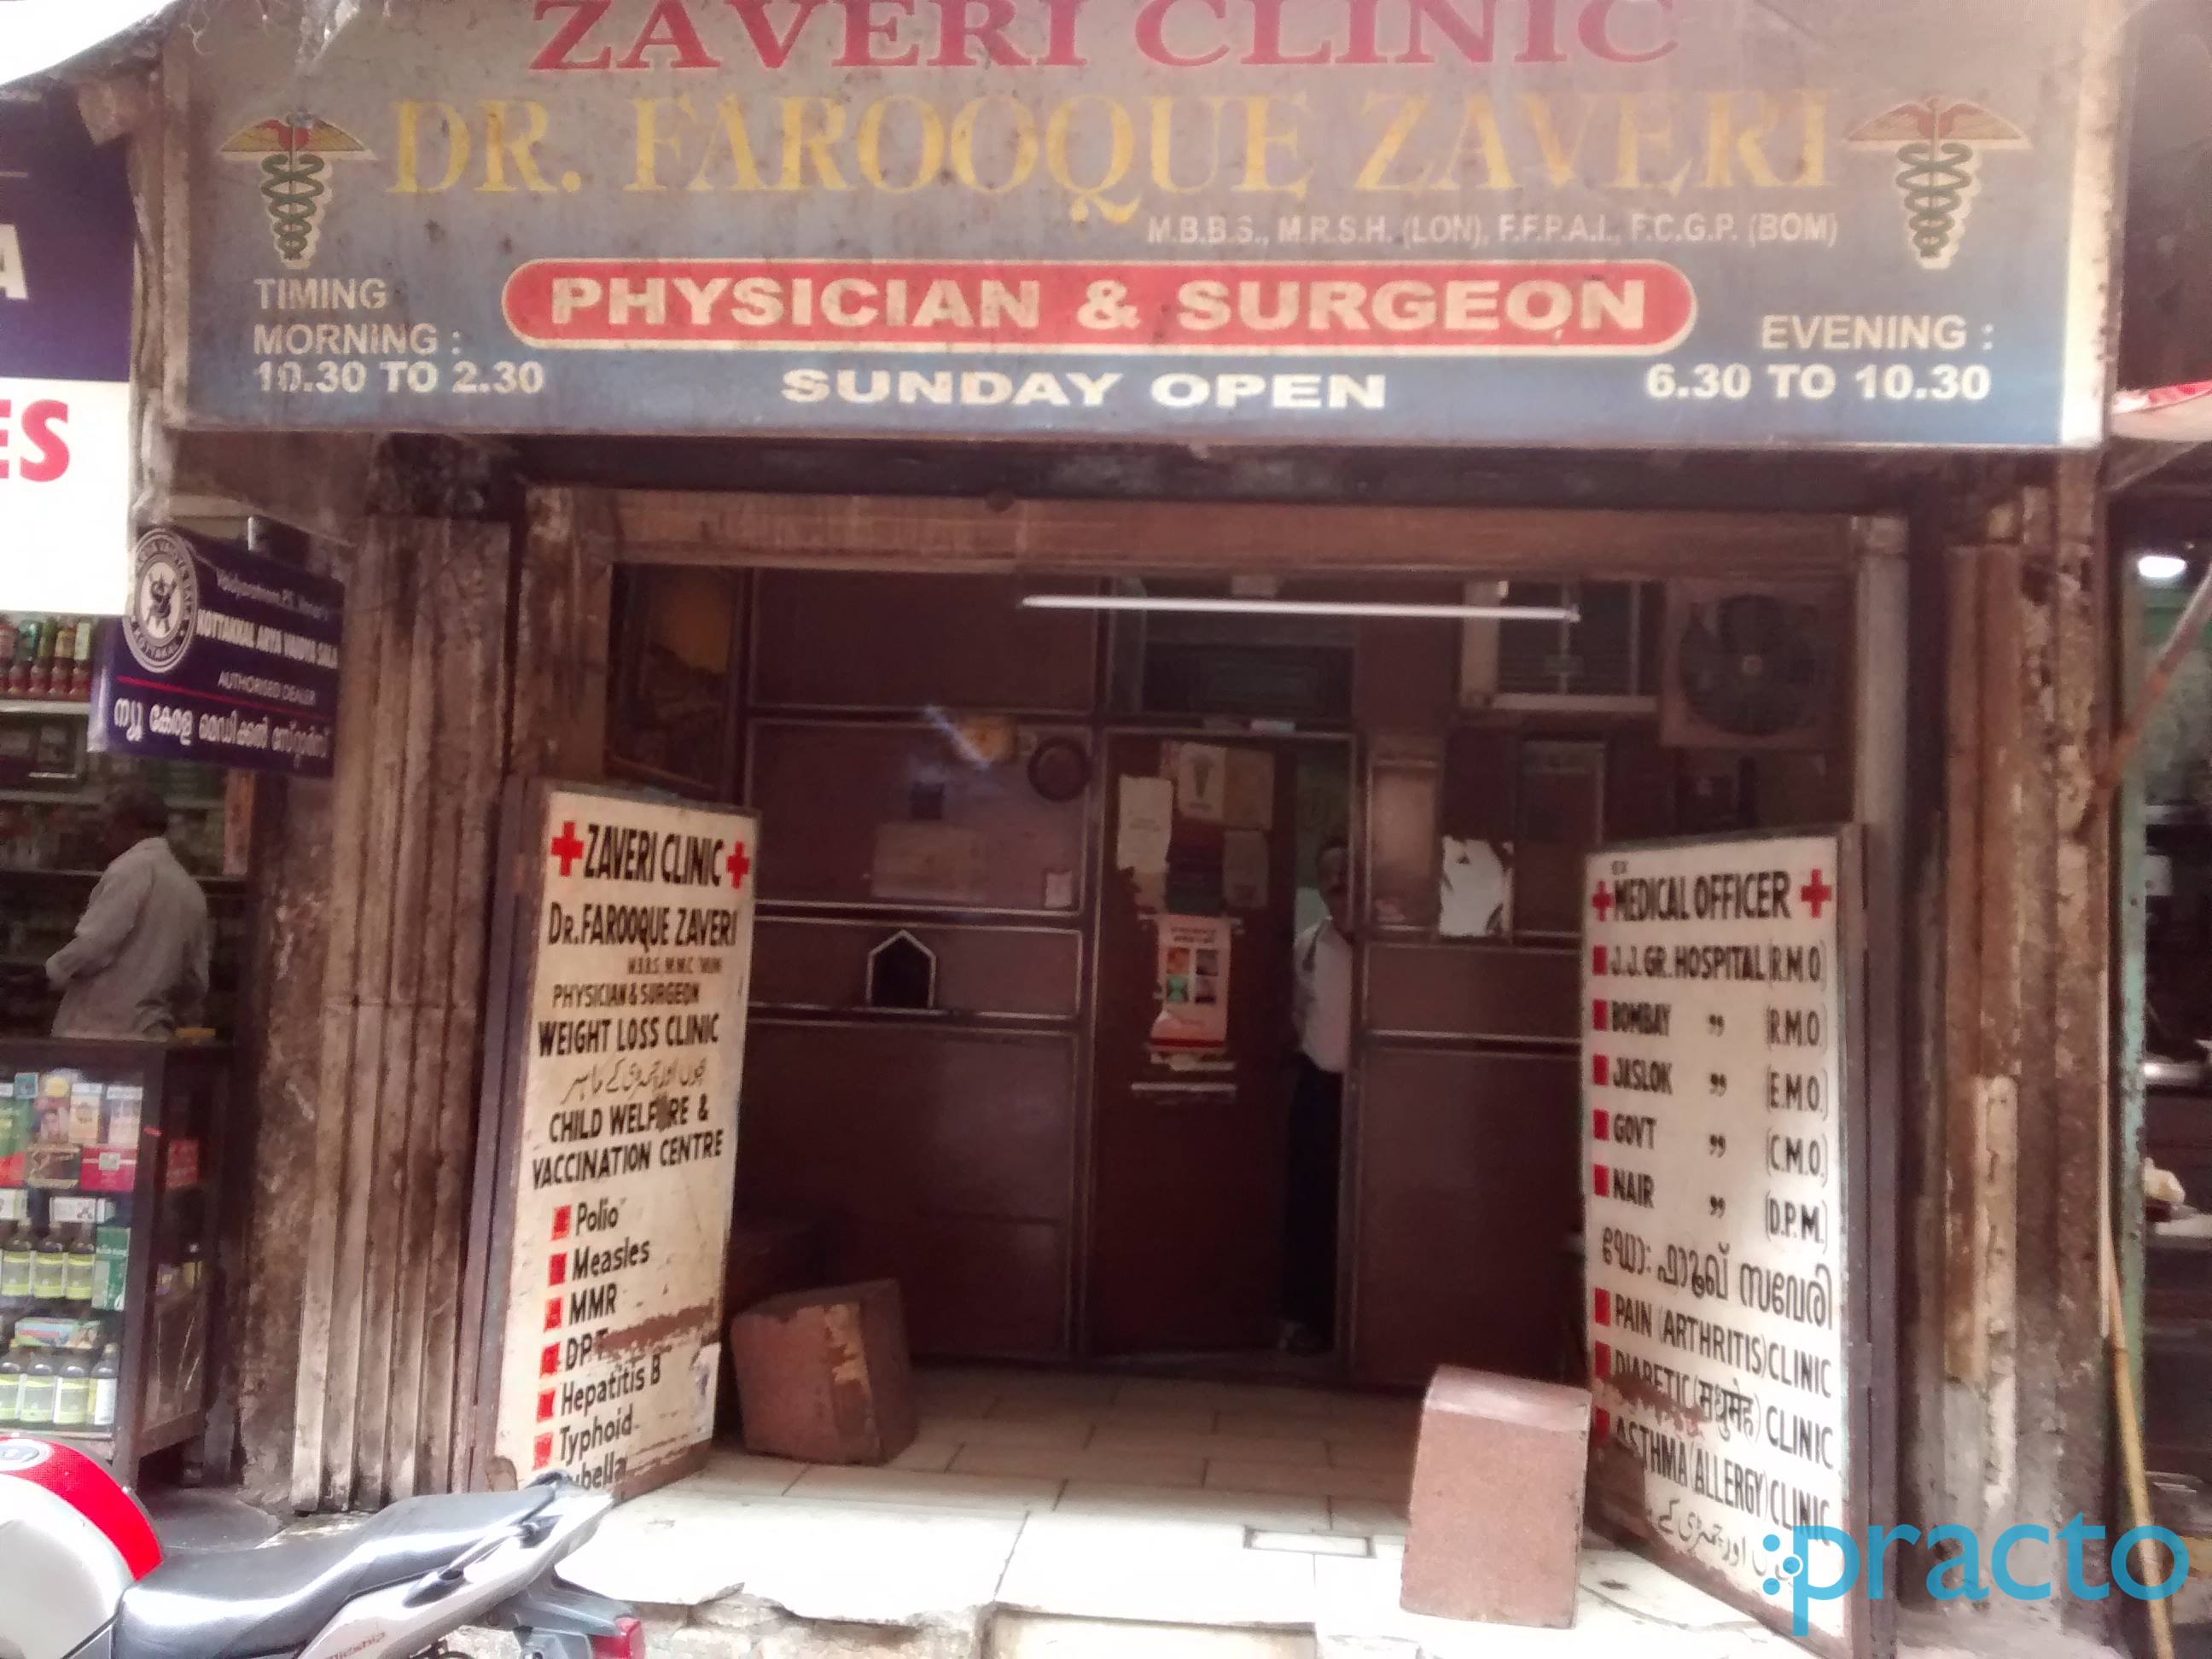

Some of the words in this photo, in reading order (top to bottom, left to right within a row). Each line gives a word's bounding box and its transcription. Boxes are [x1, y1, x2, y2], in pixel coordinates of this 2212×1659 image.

[528, 0, 1087, 70] ZAVERI
[1135, 0, 1679, 66] CLINIC
[386, 98, 583, 195] DR.
[623, 92, 1314, 224] FAROOQUE
[1352, 89, 1833, 199] ZAVERI
[254, 277, 387, 311] TIMING
[551, 276, 1040, 328] PHYSICIAN
[1078, 280, 1141, 330] &
[1177, 278, 1644, 332] SURGEON
[253, 323, 438, 355] MORNING
[1761, 314, 1966, 351] EVENING
[253, 361, 365, 394] 10.30
[381, 362, 435, 394] TO
[453, 360, 544, 395] 2.30
[781, 370, 1122, 408] SUNDAY
[1150, 372, 1387, 410] OPEN
[1645, 364, 1751, 399] 6.30
[1769, 364, 1837, 400] TO
[1854, 364, 1992, 401] 10.30
[0, 399, 70, 483] S
[583, 823, 658, 882] ZAVERI
[661, 832, 725, 888] CLINIC
[1615, 876, 1690, 923] MEDICAL
[1694, 870, 1792, 921] OFFICER
[674, 907, 738, 947] ZAVERI
[552, 983, 626, 1009] PHYSICIAN
[640, 982, 700, 1005] SURGEON
[538, 1018, 612, 1058] WEIGHT
[617, 1016, 659, 1052] LOSS
[665, 1012, 719, 1048] CLINIC
[549, 1106, 602, 1144] CHILD
[1614, 1113, 1657, 1150] GOVT
[533, 1141, 652, 1190] VACCINATION
[659, 1128, 725, 1167] CENTRE
[1614, 1167, 1656, 1209] NAIR
[576, 1197, 619, 1237] Polio
[572, 1237, 650, 1282] Measles
[568, 1283, 618, 1327] MMR
[1615, 1293, 1652, 1338] PAIN
[1768, 1342, 1831, 1399] CLINIC
[560, 1359, 645, 1417] Hepatitis
[650, 1354, 661, 1387] B
[559, 1404, 632, 1466] Typhoid
[1766, 1405, 1834, 1470] CLINIC
